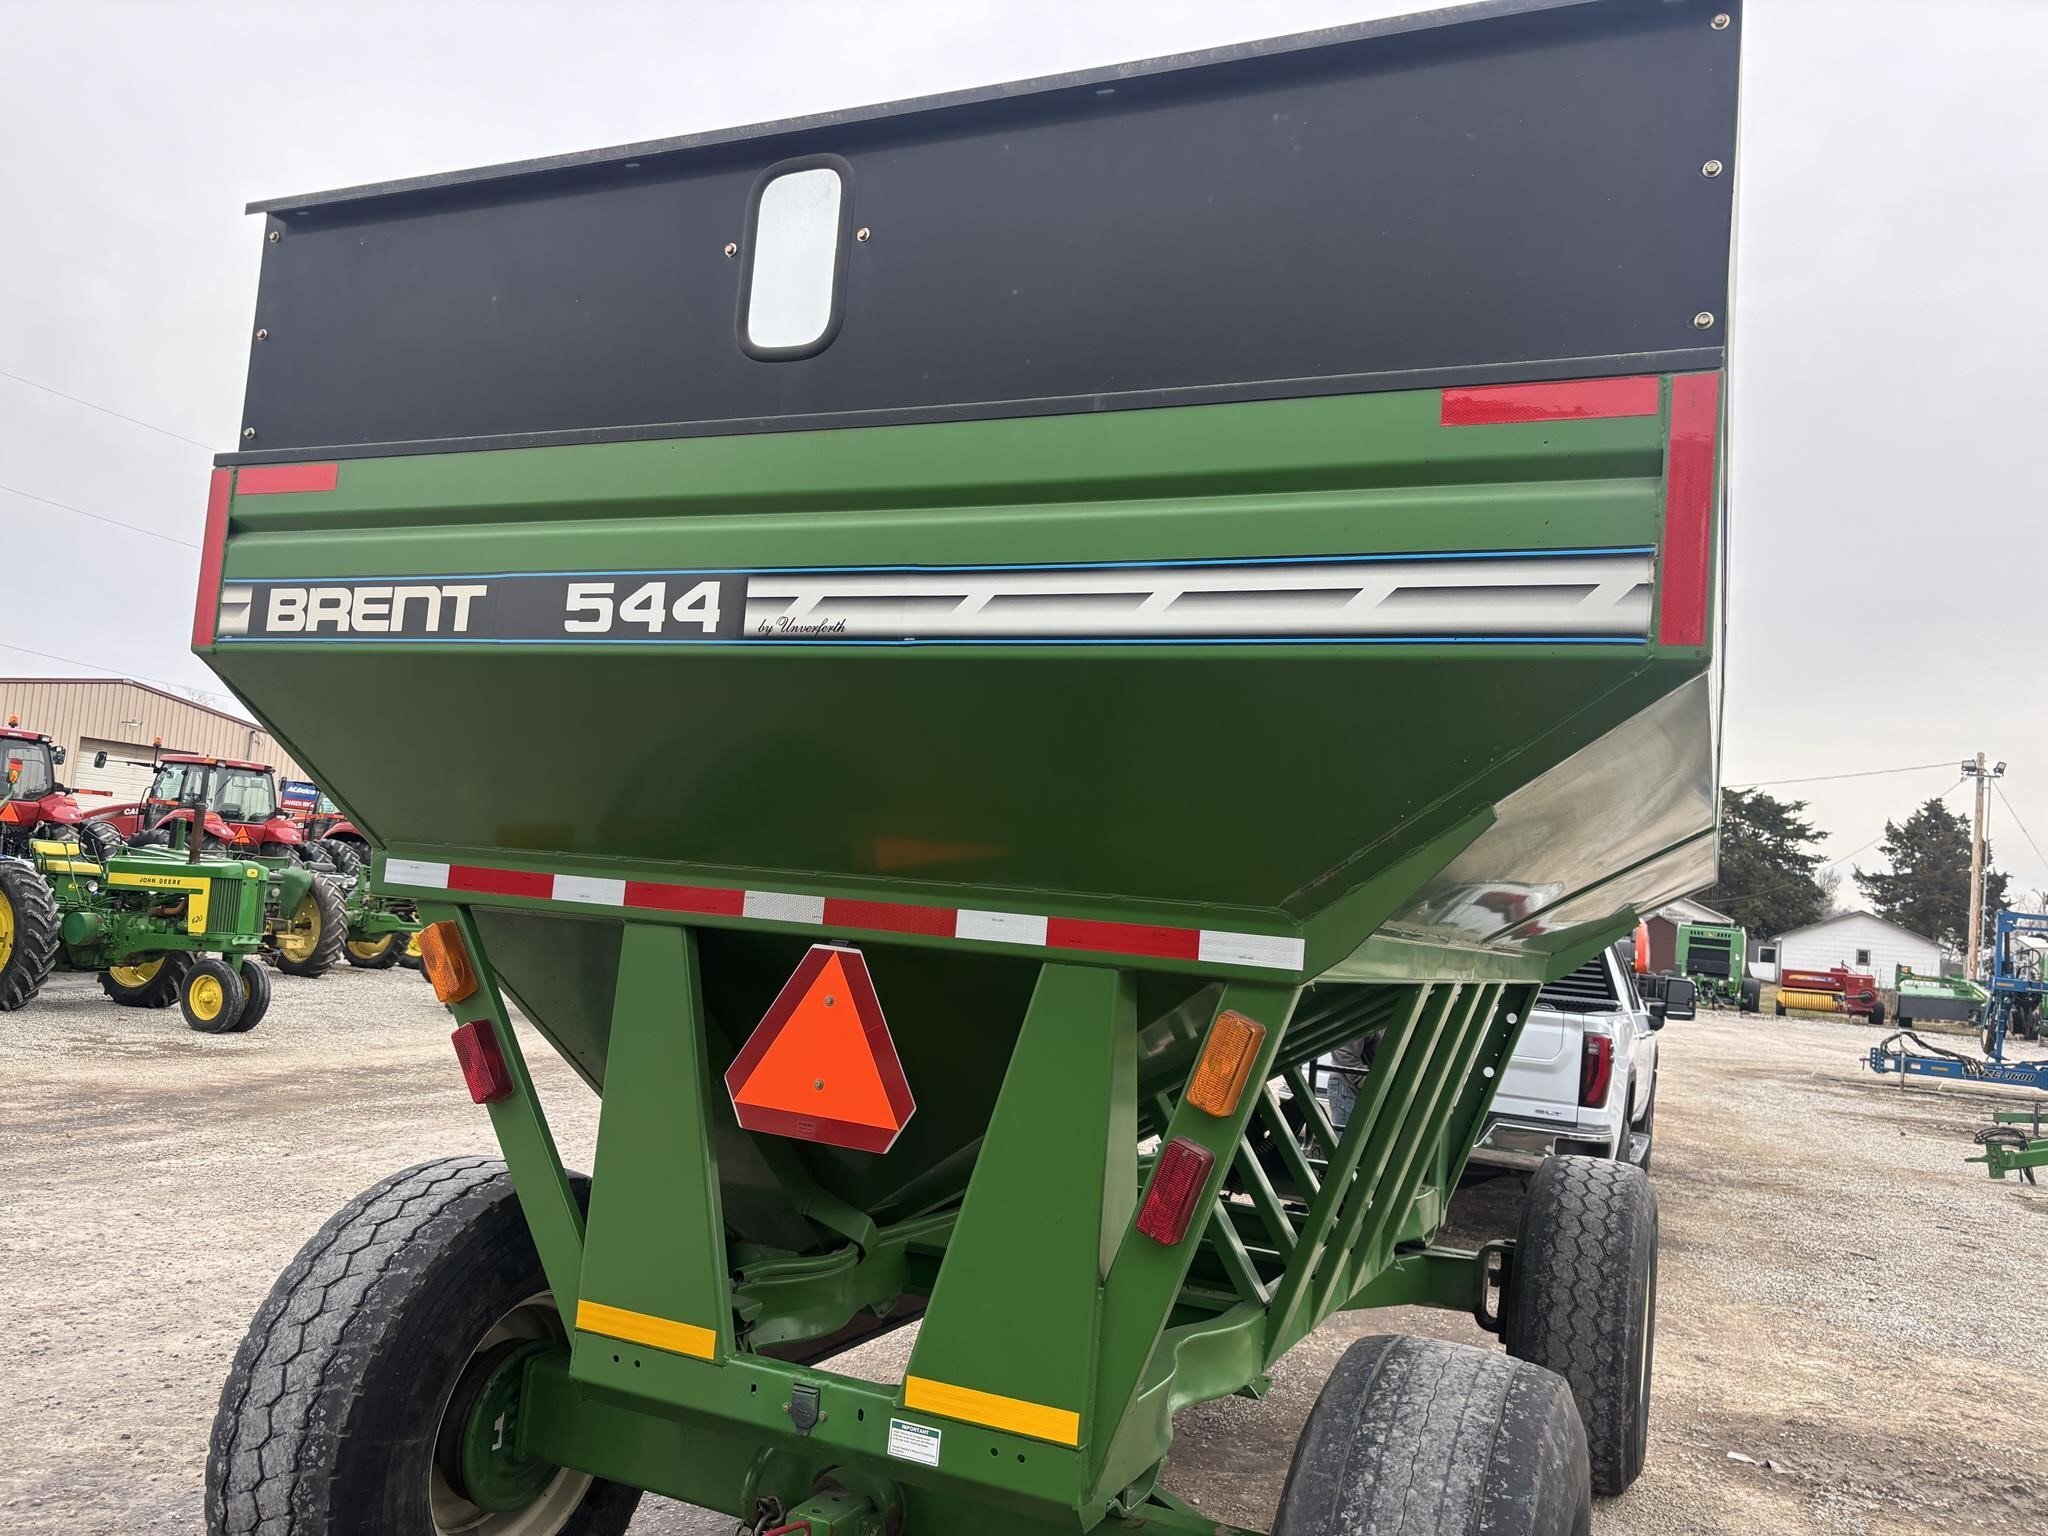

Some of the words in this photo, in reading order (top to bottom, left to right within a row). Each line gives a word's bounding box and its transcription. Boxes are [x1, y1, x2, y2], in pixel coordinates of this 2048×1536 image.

[265, 585, 488, 632] BRENT
[564, 581, 721, 633] 544
[757, 618, 774, 636] by
[775, 615, 847, 638] Unverferth
[159, 878, 181, 886] DEERE
[191, 914, 203, 924] 620
[2003, 1071, 2036, 1082] 3600
[901, 1423, 930, 1436] IMPORTANT
